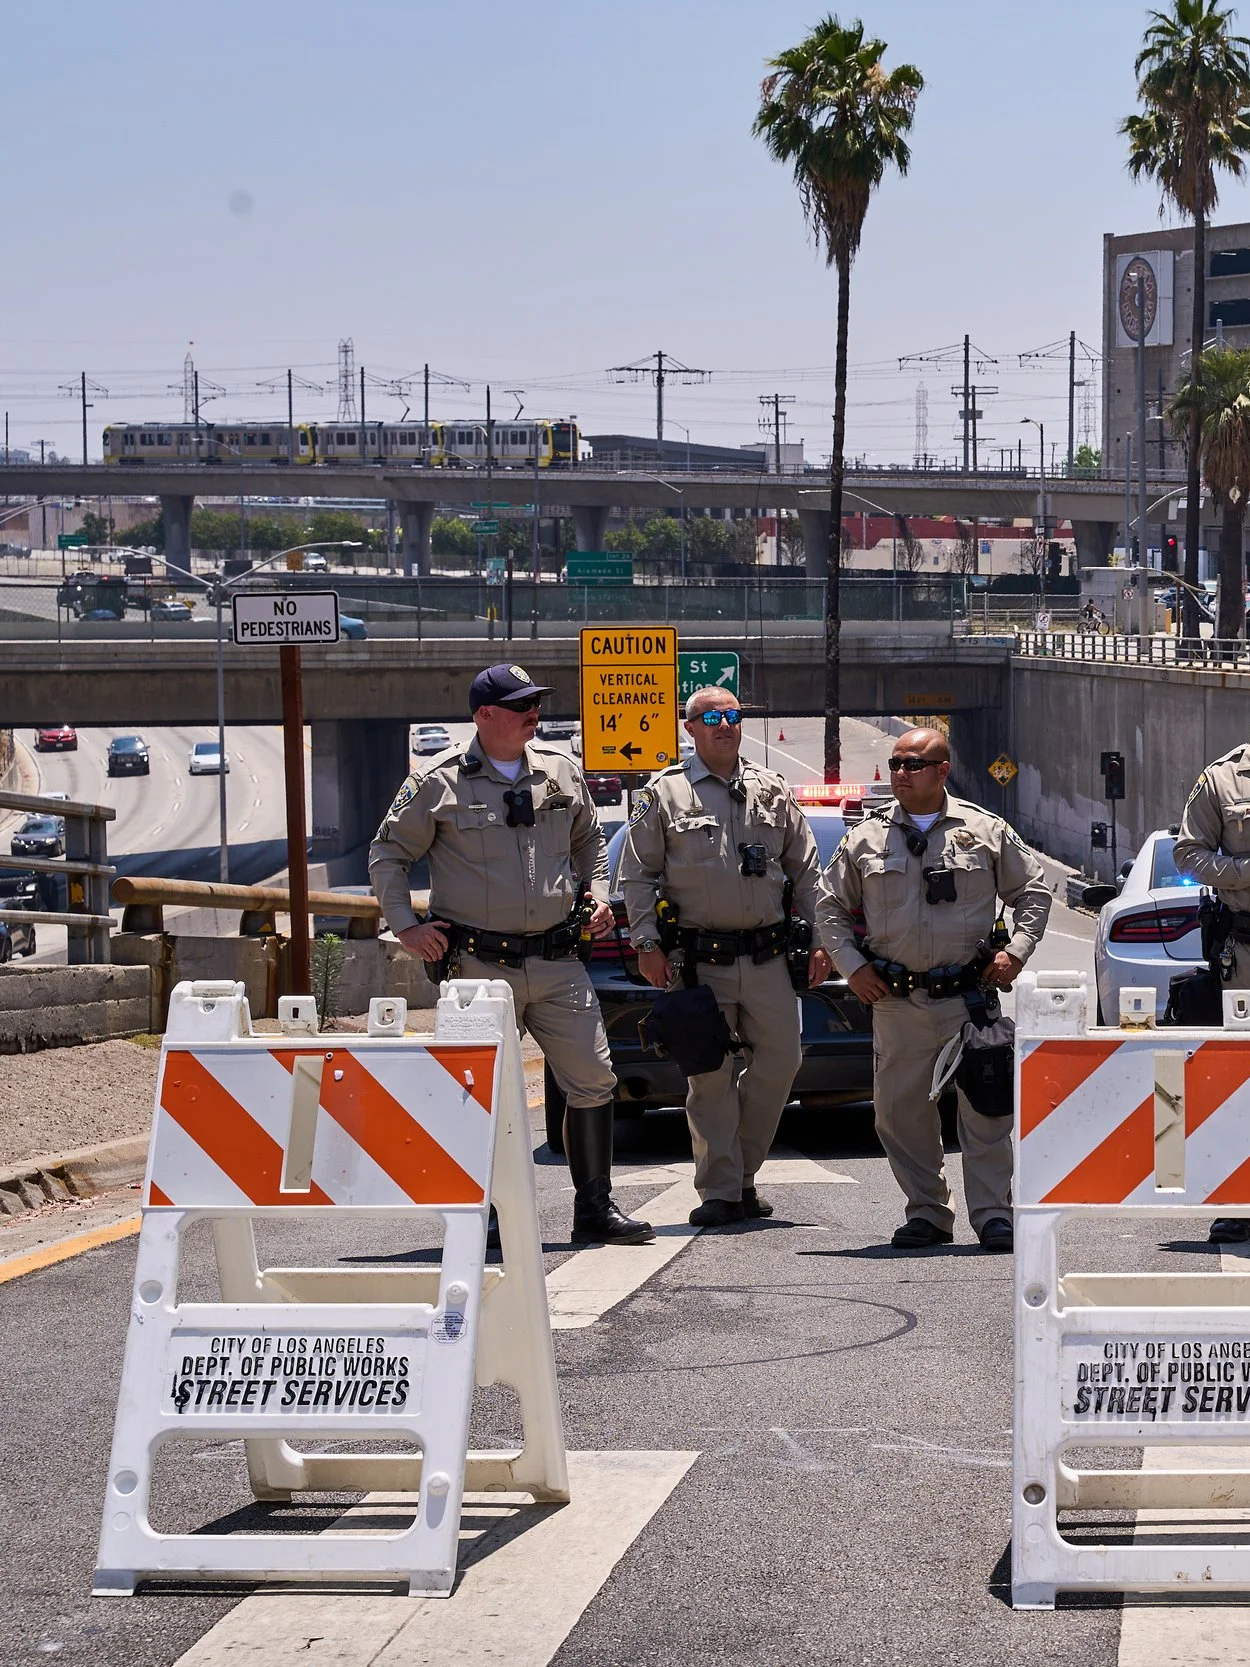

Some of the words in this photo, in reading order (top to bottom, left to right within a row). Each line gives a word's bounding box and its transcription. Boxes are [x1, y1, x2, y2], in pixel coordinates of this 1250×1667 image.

[273, 600, 297, 616] NO
[241, 620, 331, 637] PEDESTRIANS
[591, 636, 666, 655] CAUTION
[690, 660, 708, 674] St
[599, 673, 658, 686] VERTICAL
[593, 692, 666, 705] CLEARANCE
[599, 713, 623, 732] 14'
[211, 1337, 247, 1354] CITY
[251, 1337, 272, 1354] OF
[276, 1337, 308, 1354] LOS
[312, 1337, 385, 1354] ANGELES
[1104, 1342, 1140, 1359] CITY
[1145, 1342, 1166, 1359] OF
[1171, 1342, 1202, 1359] LOS
[180, 1356, 233, 1377] DEPT.
[240, 1356, 265, 1377] OF
[270, 1356, 337, 1377] PUBLIC
[343, 1356, 409, 1377] WORKS
[1077, 1361, 1130, 1383] DEPT.
[1136, 1361, 1160, 1383] OF
[1167, 1361, 1235, 1383] PUBLIC
[177, 1379, 278, 1406] STREET
[280, 1379, 410, 1406] SERVICES
[1073, 1385, 1177, 1414] STREET
